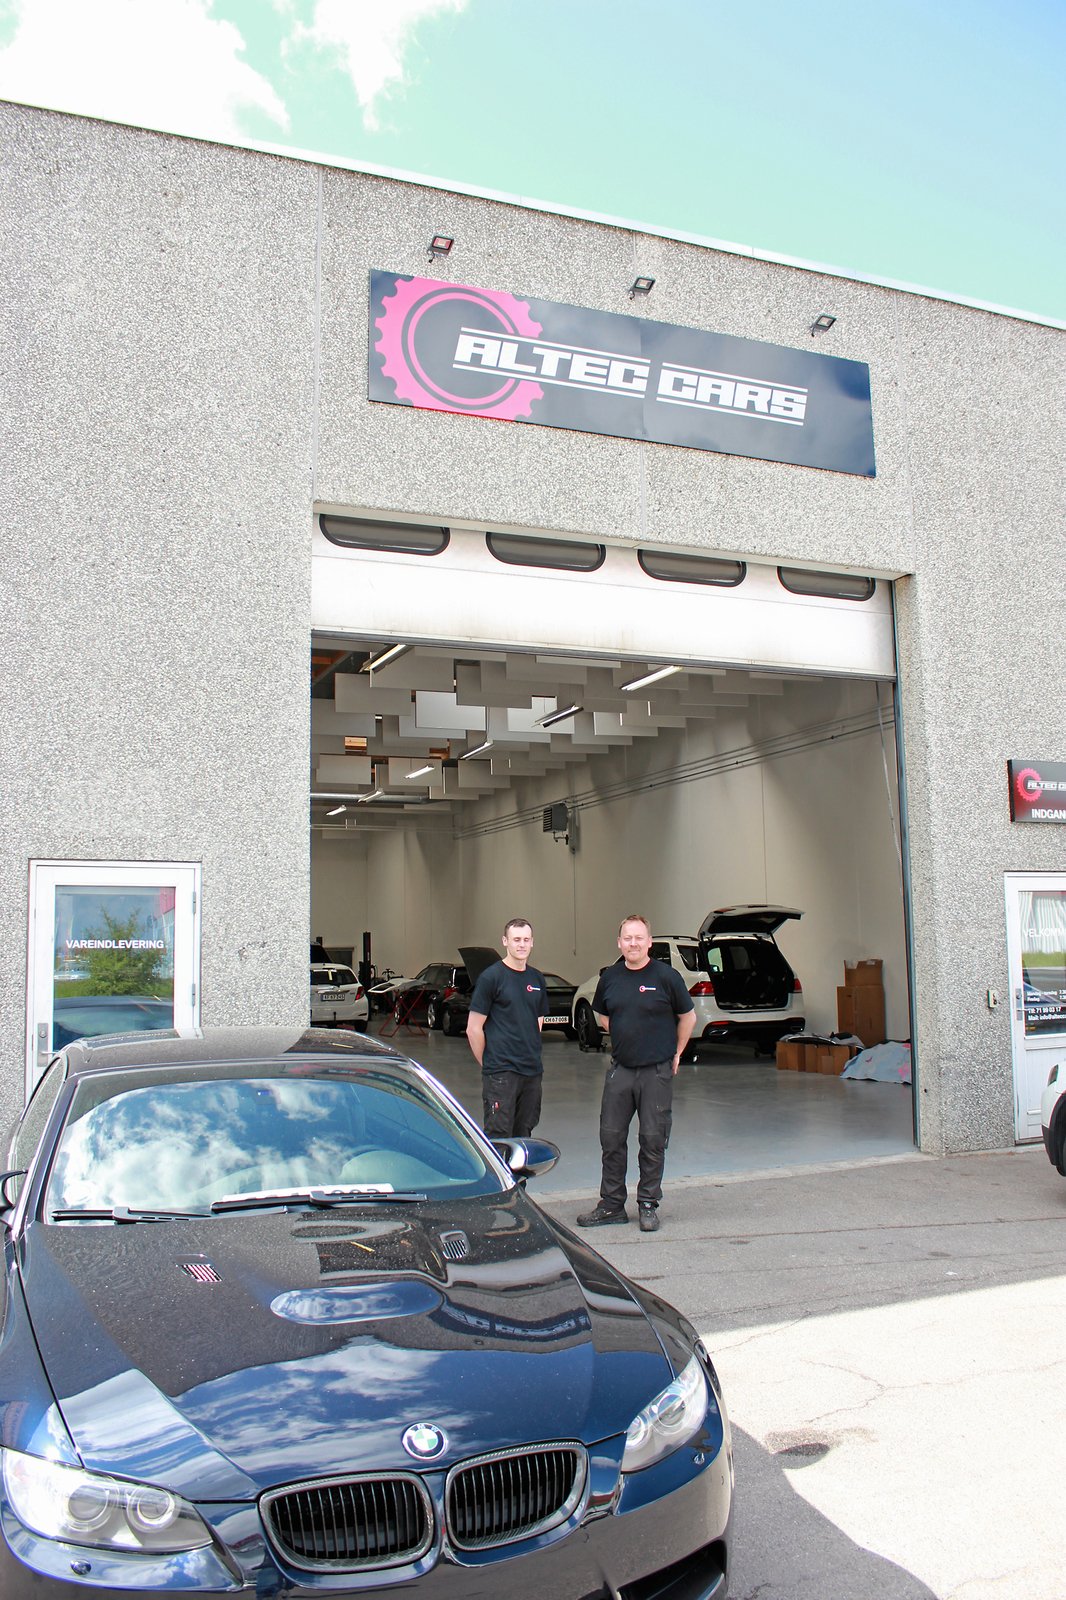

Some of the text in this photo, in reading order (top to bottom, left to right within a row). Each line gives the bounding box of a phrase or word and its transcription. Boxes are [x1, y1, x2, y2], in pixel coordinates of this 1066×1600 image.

[453, 330, 808, 424] ALTEC CARS
[65, 939, 165, 949] VAREINDLEVERING
